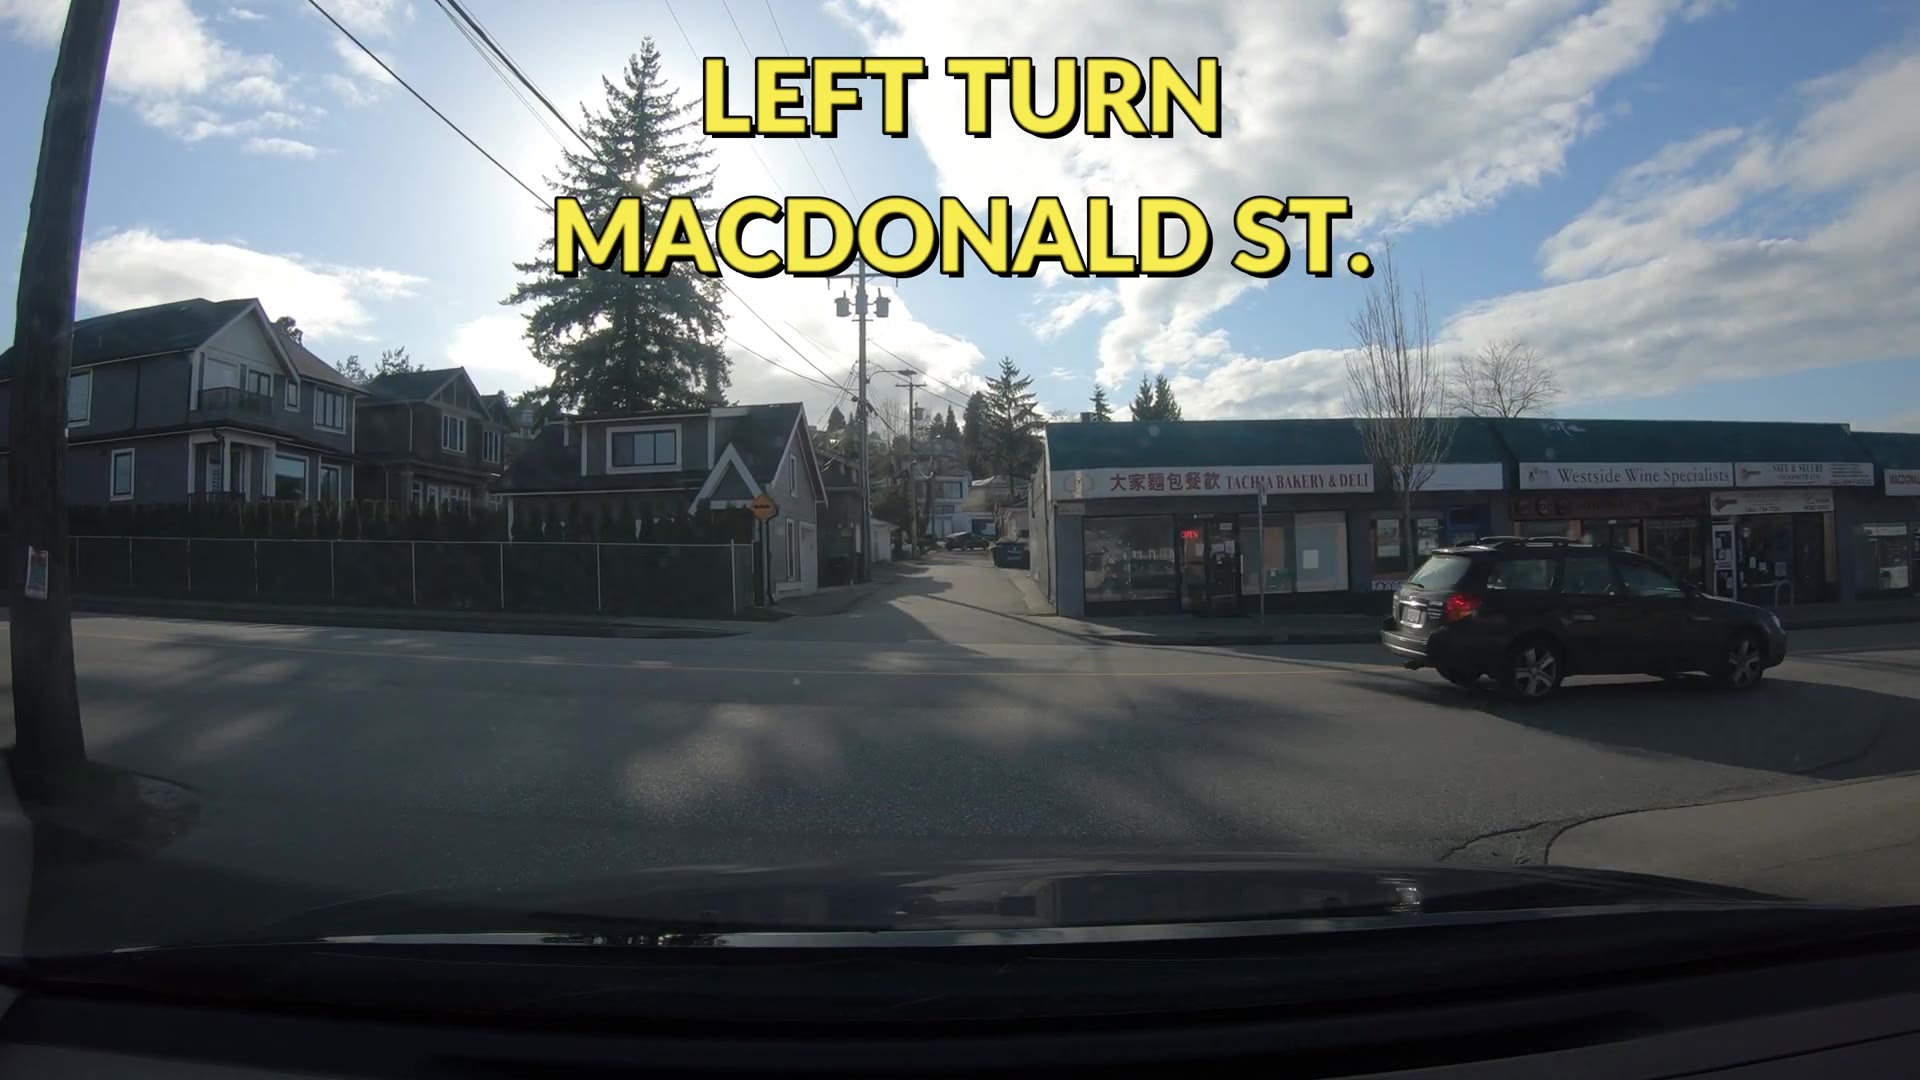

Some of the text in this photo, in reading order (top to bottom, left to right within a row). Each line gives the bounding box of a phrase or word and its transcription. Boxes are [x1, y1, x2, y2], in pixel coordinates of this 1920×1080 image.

[1557, 467, 1621, 483] Westside
[1624, 467, 1660, 483] Wine
[1663, 467, 1729, 486] Specialists
[1771, 463, 1788, 473] SAFE
[1798, 463, 1824, 473] SECURE
[1277, 474, 1325, 489] BAKERY
[1328, 473, 1337, 488] &
[1340, 472, 1368, 488] DELI
